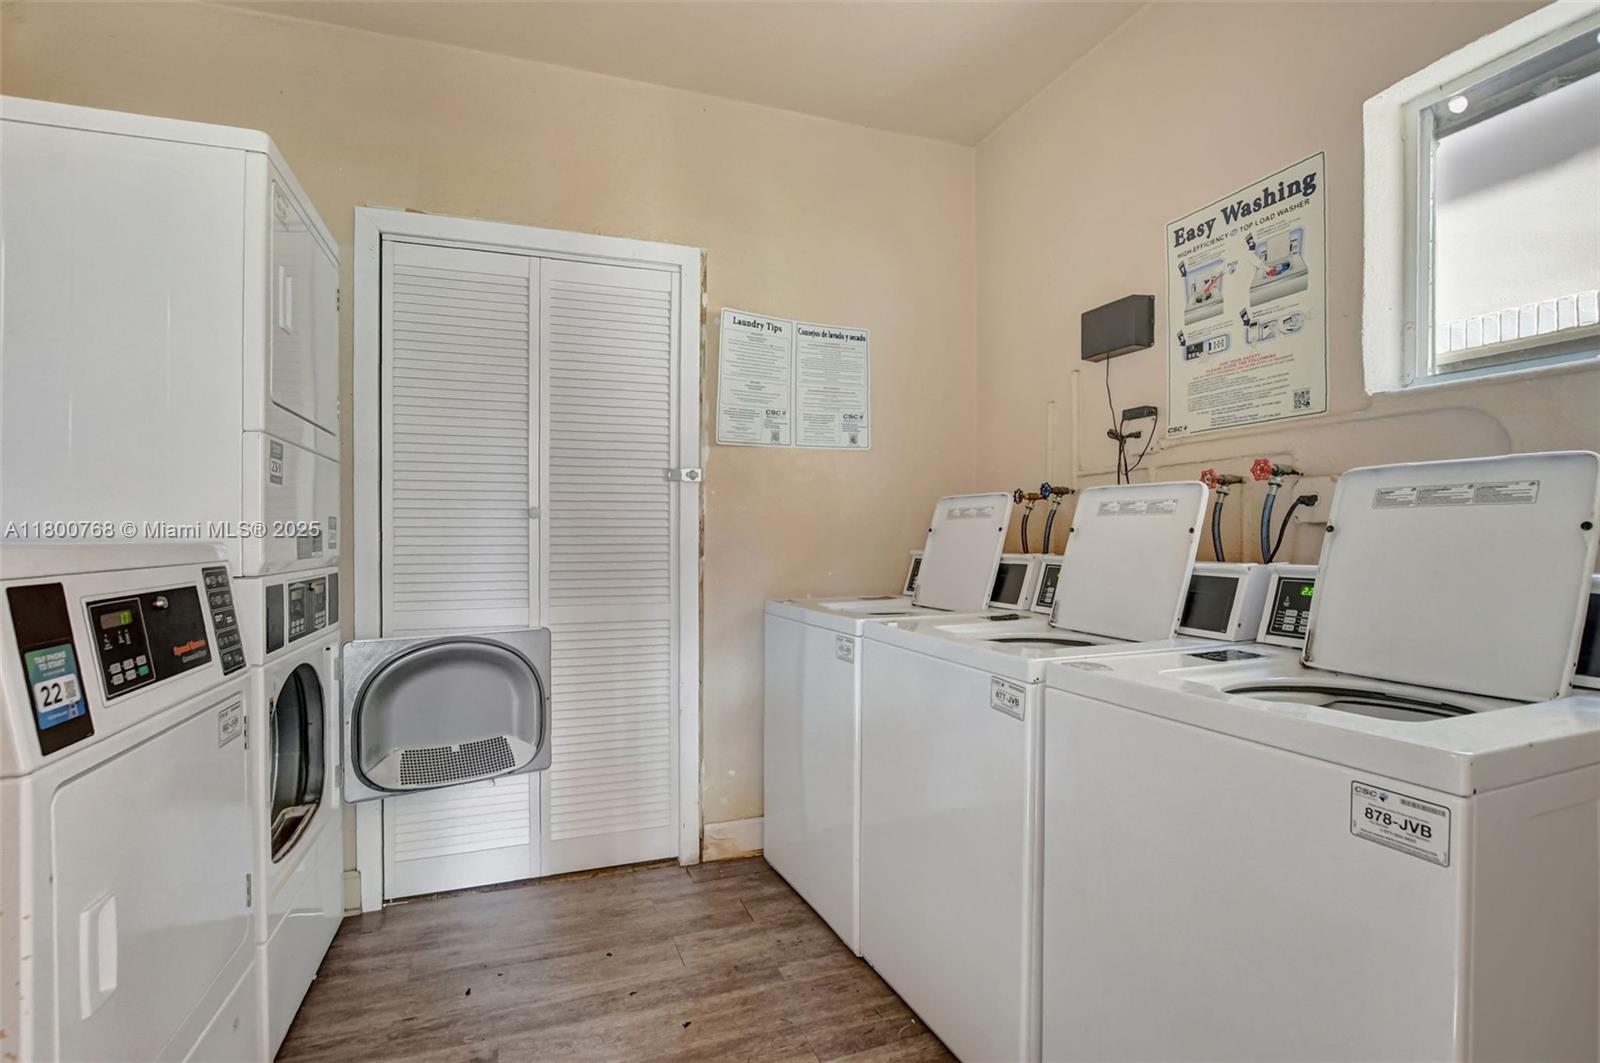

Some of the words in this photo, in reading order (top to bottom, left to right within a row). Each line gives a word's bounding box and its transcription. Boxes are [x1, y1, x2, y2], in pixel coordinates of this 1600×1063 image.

[1173, 218, 1216, 248] Easy
[1221, 172, 1317, 225] Washing
[1177, 233, 1229, 259] HIGH-EFFICIENCY
[1239, 222, 1254, 232] TOP
[1255, 213, 1276, 227] LOAD
[1277, 198, 1311, 217] WASHER
[732, 316, 764, 331] Laundry
[765, 321, 783, 333] Tips
[797, 327, 821, 338] Consejos
[828, 331, 845, 341] lavado
[849, 334, 866, 342] secado
[40, 682, 63, 707] 22
[1354, 786, 1378, 798] CSC
[1364, 807, 1432, 838] 878-JVB
